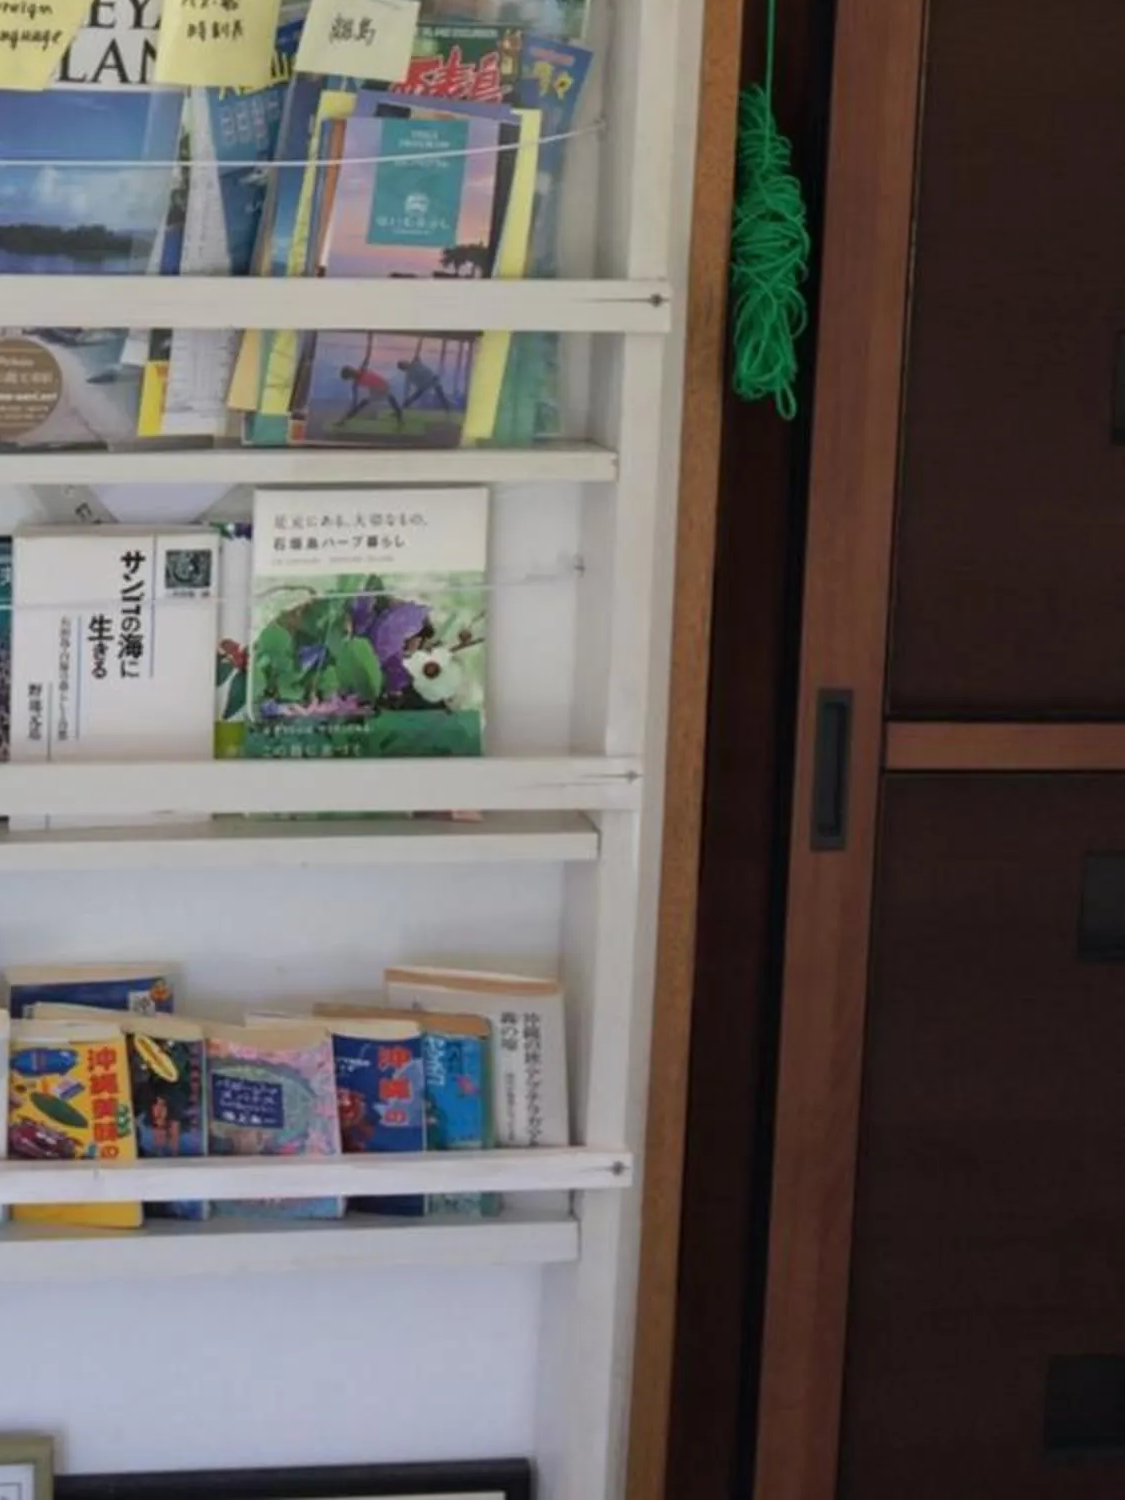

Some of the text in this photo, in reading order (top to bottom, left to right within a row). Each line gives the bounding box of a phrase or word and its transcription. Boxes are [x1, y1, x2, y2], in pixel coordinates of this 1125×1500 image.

[186, 18, 245, 42] 時刻表
[328, 15, 377, 48] 離島
[116, 550, 146, 679] サンゴの海に
[87, 613, 115, 680] 生きる
